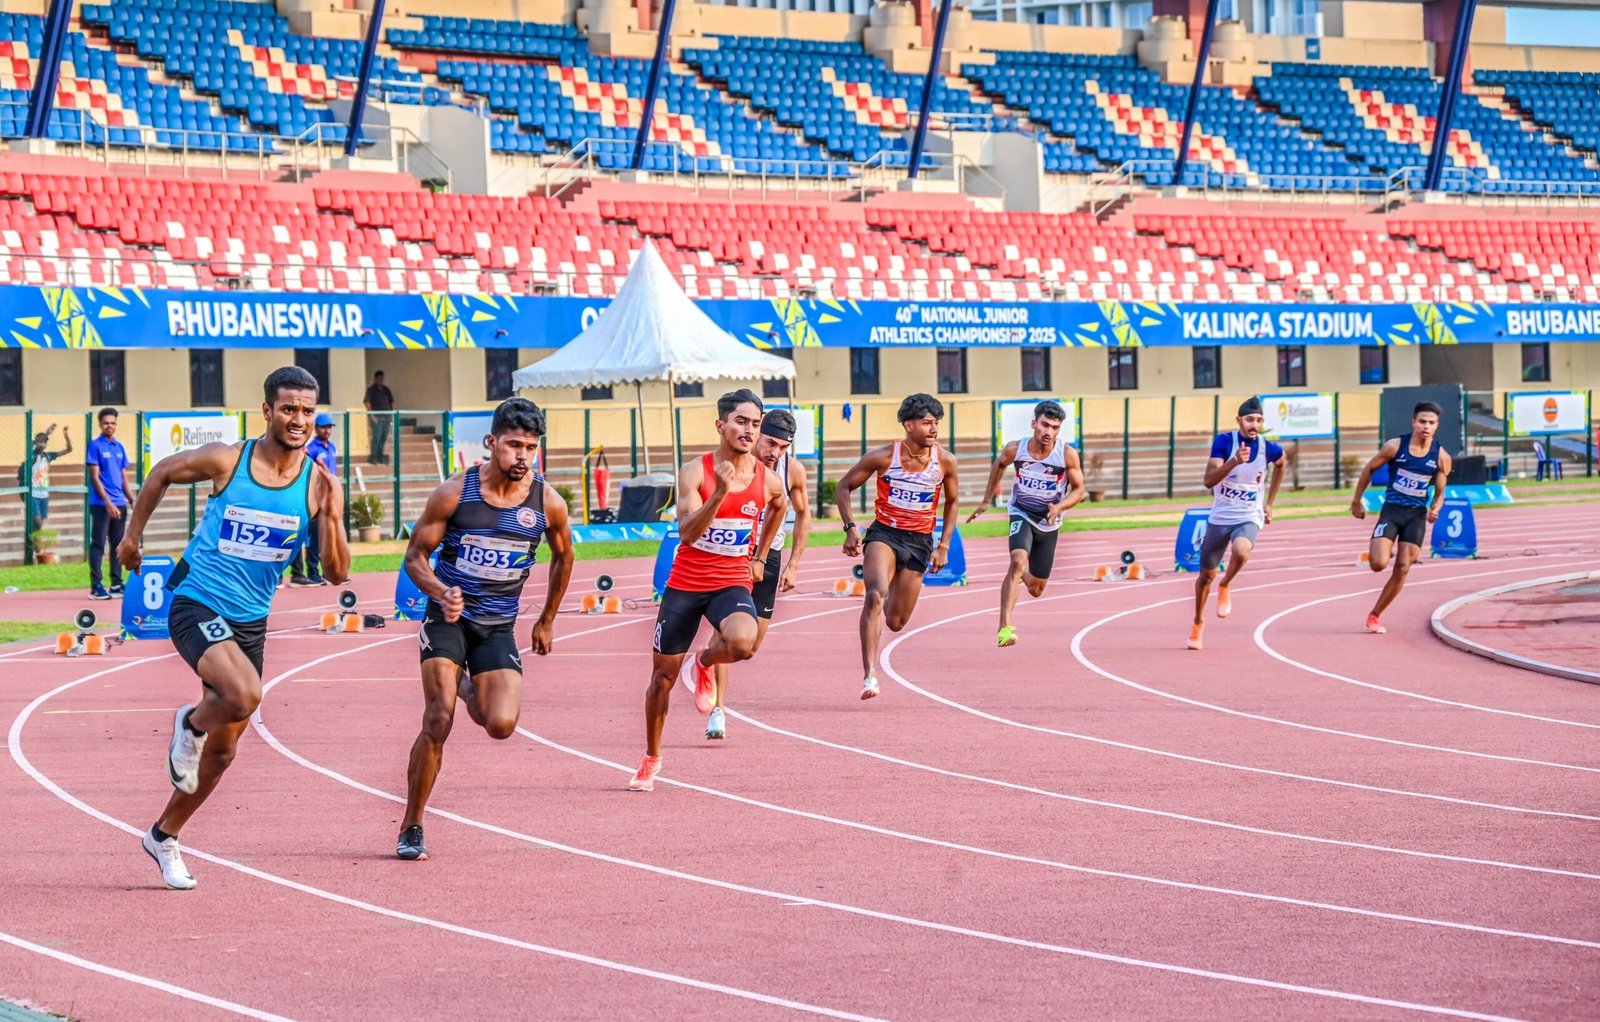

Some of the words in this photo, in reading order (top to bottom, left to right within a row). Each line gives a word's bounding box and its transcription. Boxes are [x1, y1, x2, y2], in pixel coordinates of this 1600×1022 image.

[167, 300, 363, 337] BHUBANESWAR
[921, 306, 982, 323] NATIONAL
[983, 307, 1029, 323] JUNIOR
[1183, 312, 1275, 338] KALINGA
[1278, 312, 1373, 338] STADIUM
[869, 326, 933, 343] ATHLETICS
[934, 326, 1027, 343] CHAMPIONSHIP
[1028, 326, 1057, 343] 2025
[183, 426, 223, 446] Reliance
[1020, 475, 1048, 490] 1786
[1398, 476, 1419, 489] 419
[891, 487, 921, 503] 985
[1011, 522, 1019, 533] 3
[1446, 510, 1463, 538] 3
[230, 521, 270, 547] 152
[462, 544, 511, 569] 1893
[143, 571, 164, 610] 8
[206, 622, 226, 638] 8
